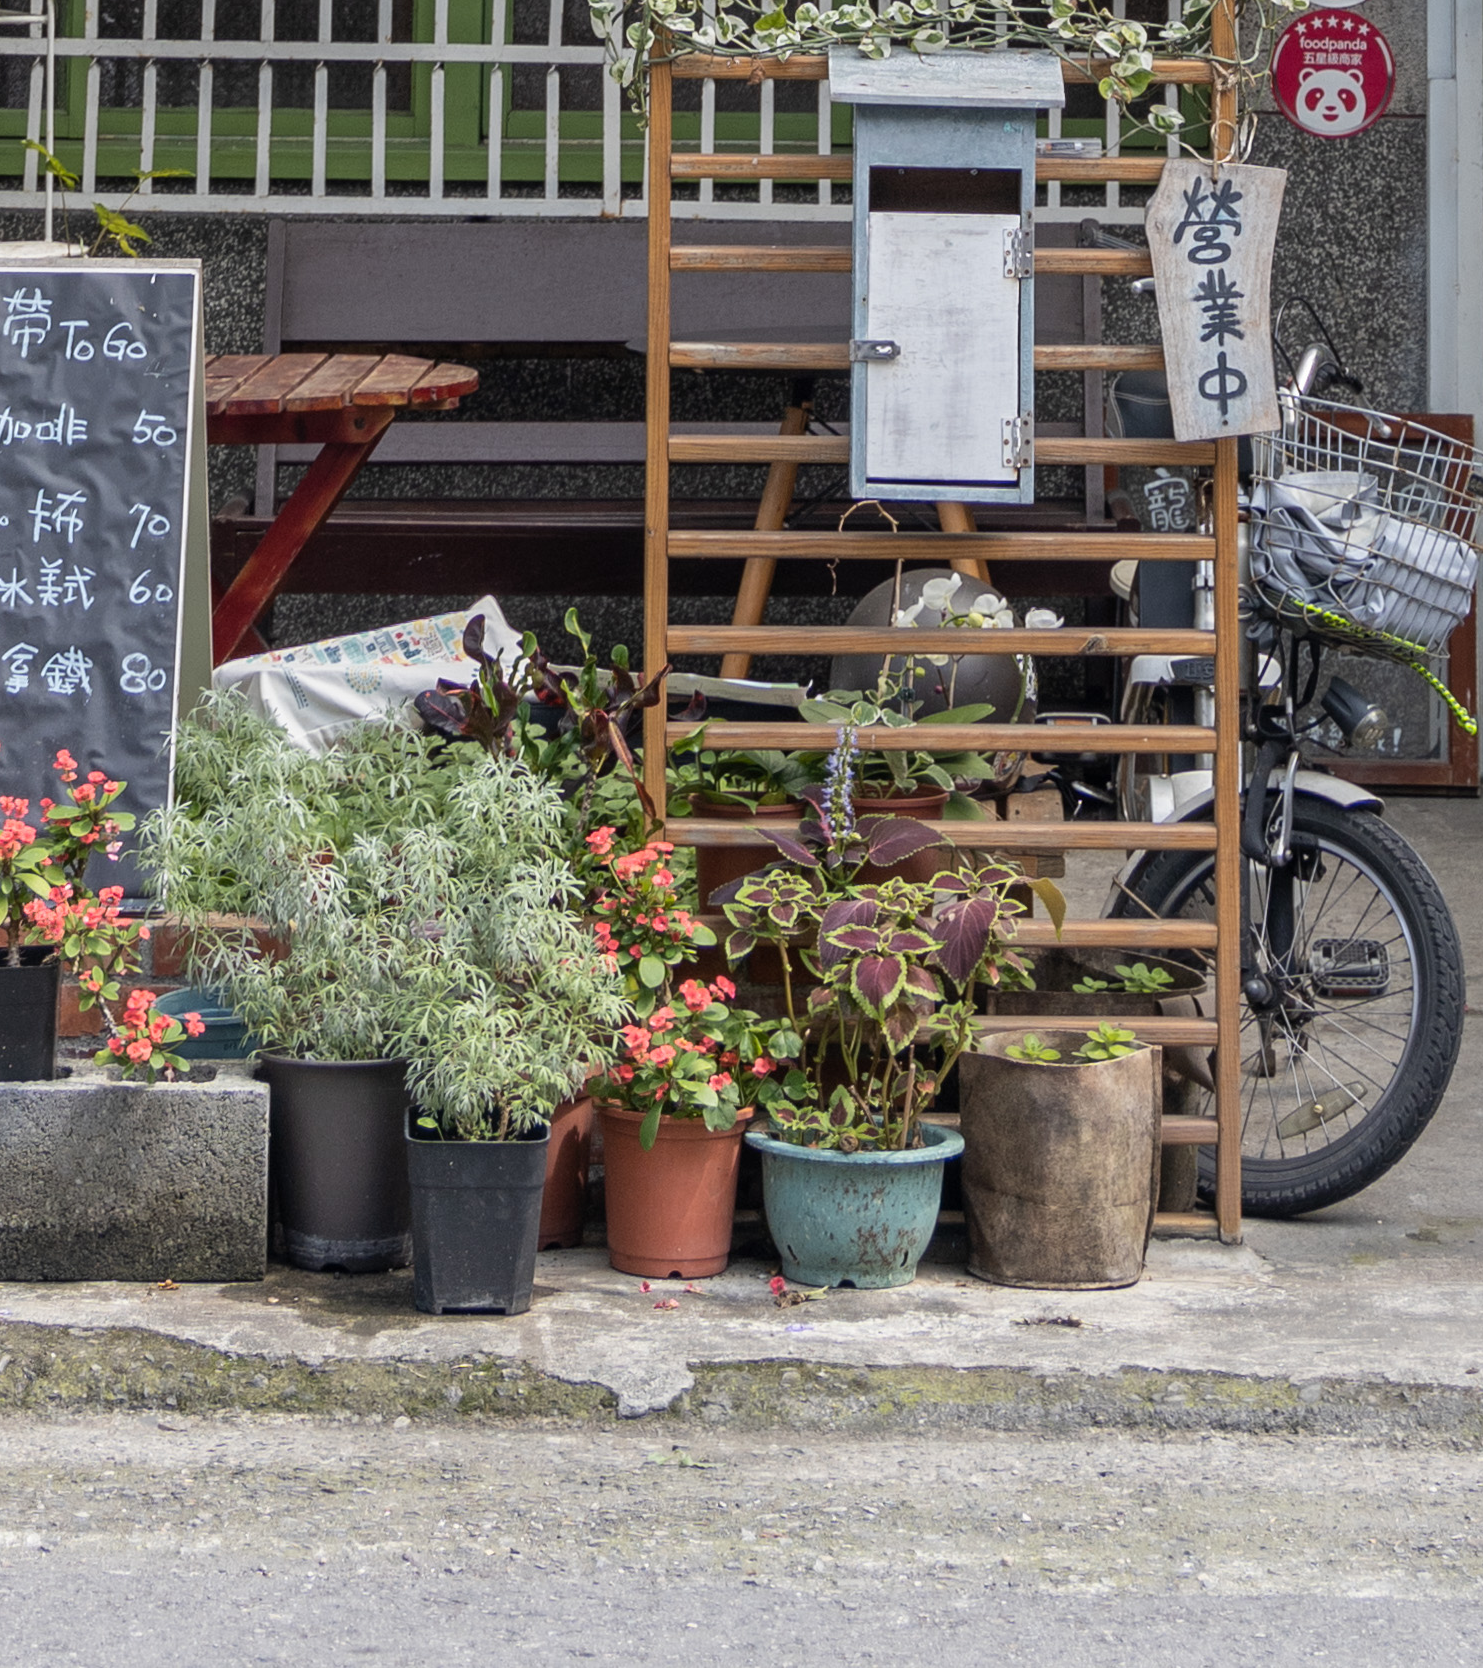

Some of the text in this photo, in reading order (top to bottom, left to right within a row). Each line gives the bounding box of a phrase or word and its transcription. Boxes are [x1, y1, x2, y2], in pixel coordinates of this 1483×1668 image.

[1299, 35, 1368, 55] foodpanda
[1173, 176, 1248, 415] 營業中
[132, 409, 177, 446] 50
[129, 502, 171, 549] 70
[129, 569, 174, 606] 60
[119, 652, 167, 694] 80
